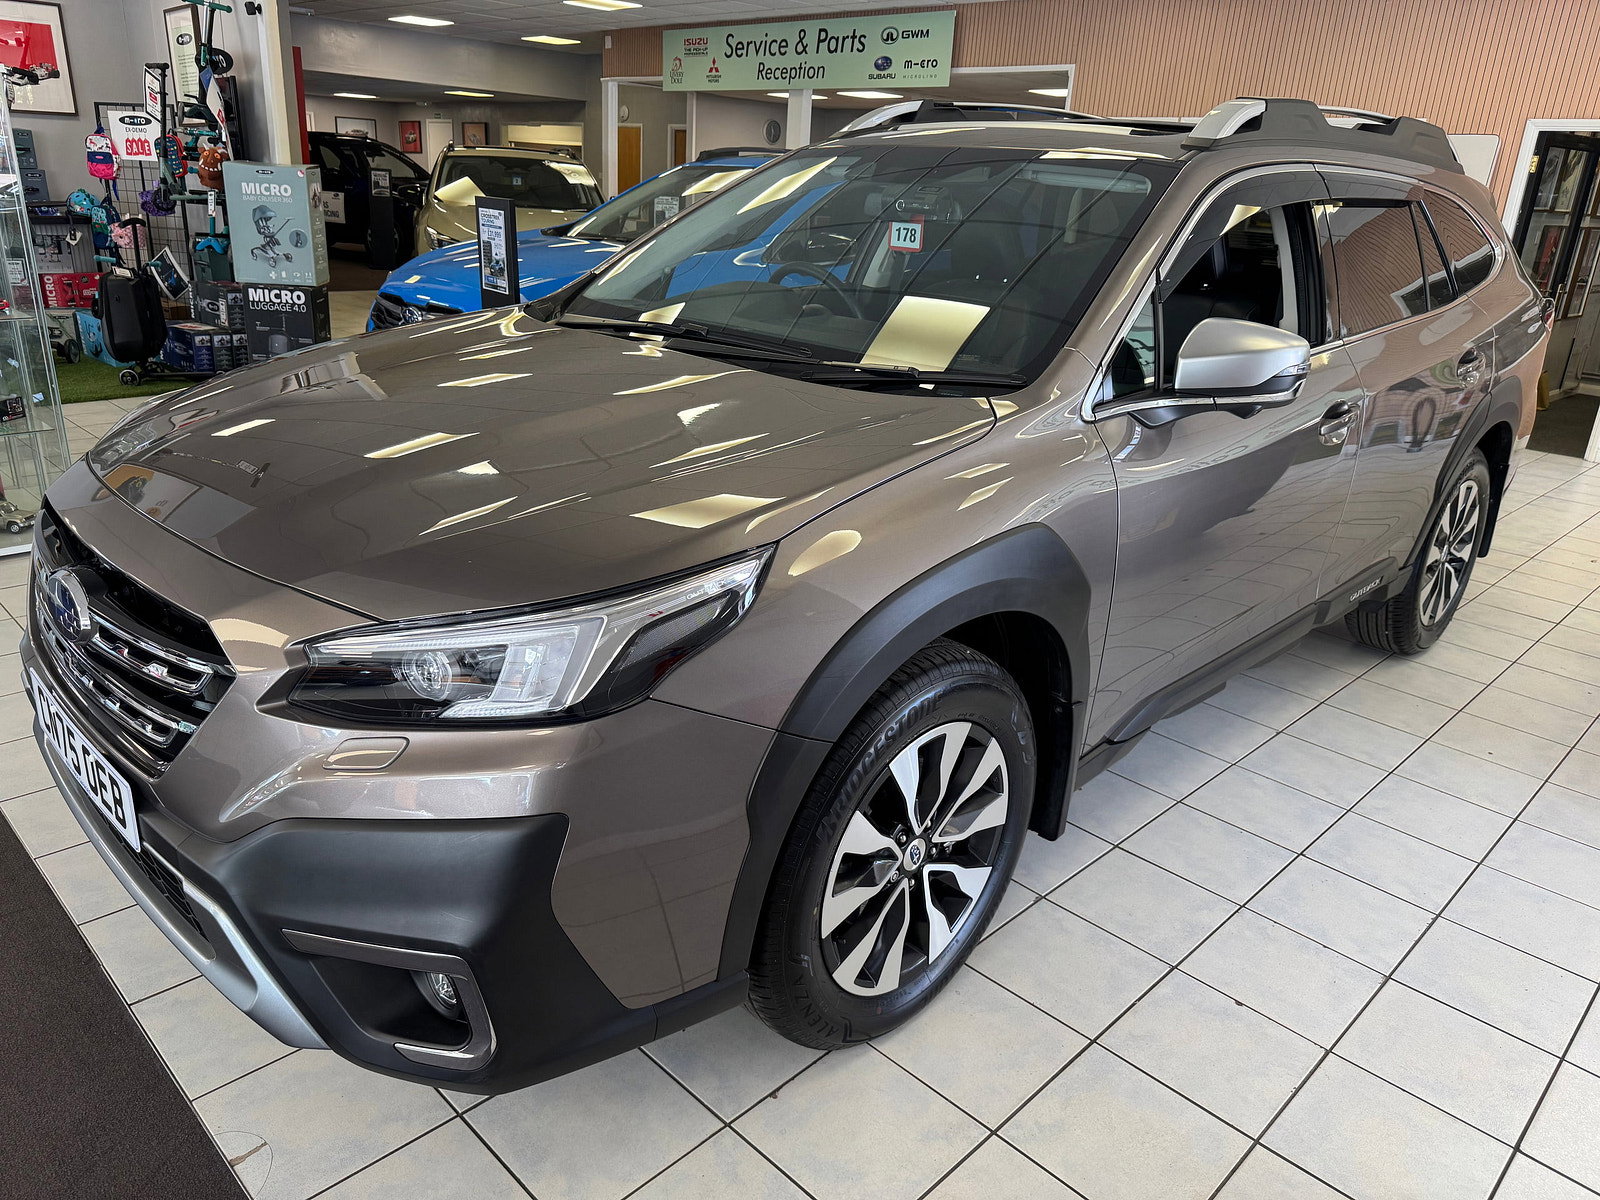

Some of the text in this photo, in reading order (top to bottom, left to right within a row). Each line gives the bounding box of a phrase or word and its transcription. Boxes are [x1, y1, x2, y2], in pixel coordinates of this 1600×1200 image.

[684, 37, 708, 46] ISUZU
[901, 29, 930, 39] GWM
[724, 28, 867, 58] Service & Parts
[757, 61, 825, 85] Reception
[126, 141, 151, 154] SALE
[241, 182, 292, 197] MICRO
[895, 226, 917, 243] 178
[247, 287, 306, 305] MICRO
[249, 301, 307, 313] LUGGAGE 4.0
